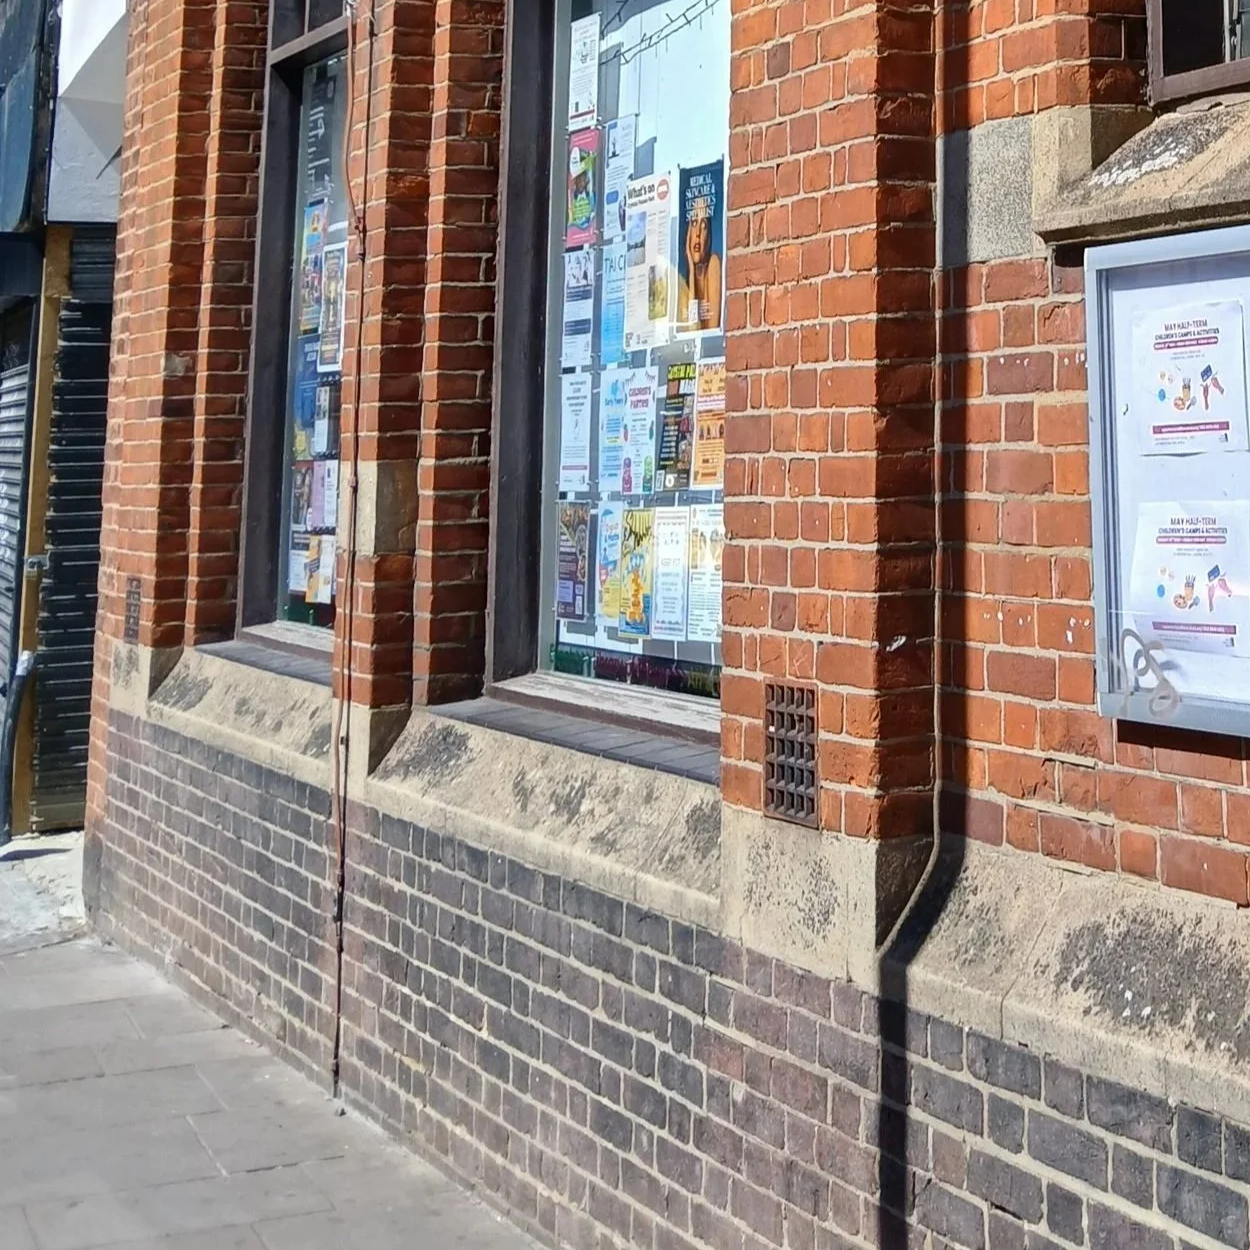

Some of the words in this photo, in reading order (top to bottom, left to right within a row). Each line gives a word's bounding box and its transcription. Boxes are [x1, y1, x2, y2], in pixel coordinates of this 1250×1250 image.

[689, 172, 712, 187] MEDICAL
[627, 184, 647, 200] What's
[685, 184, 711, 199] SKINCARE
[1164, 323, 1176, 331] MAY
[1170, 517, 1184, 526] MAY
[1186, 517, 1216, 526] HALF-TERM
